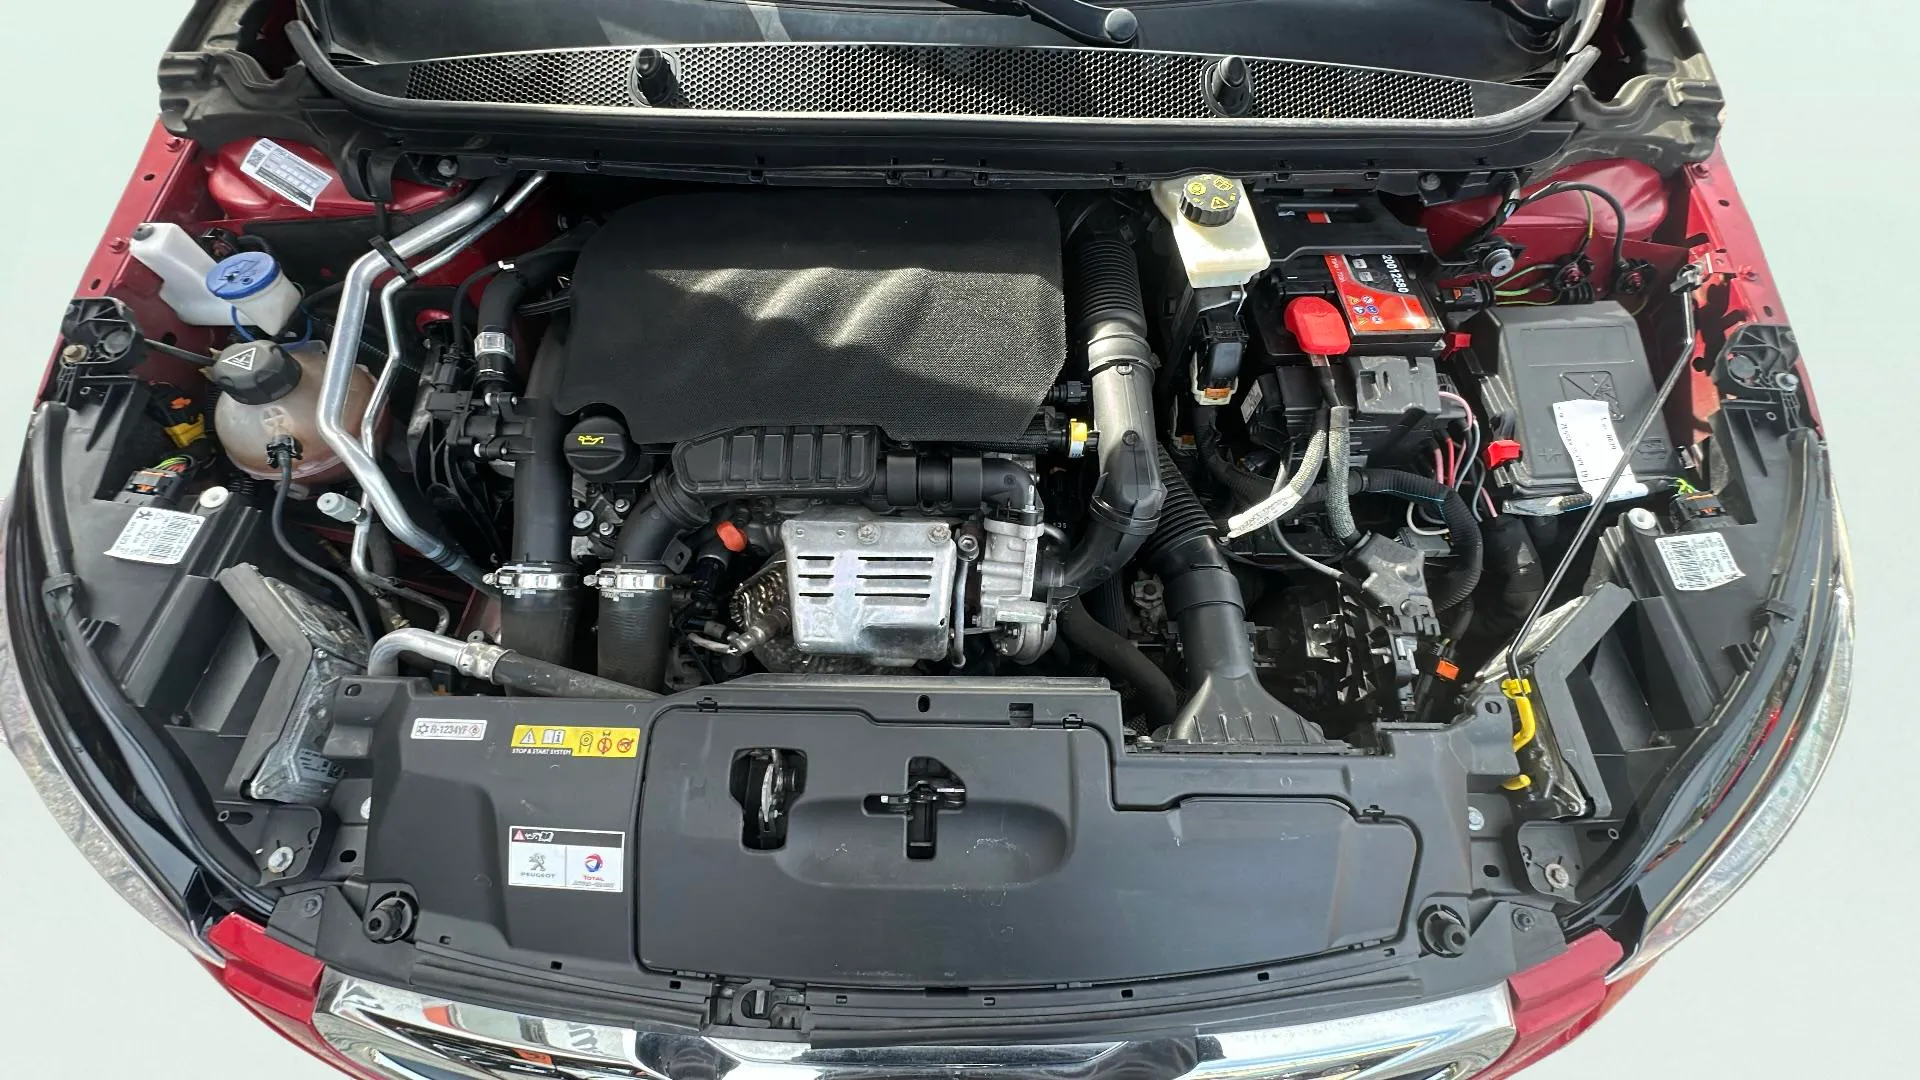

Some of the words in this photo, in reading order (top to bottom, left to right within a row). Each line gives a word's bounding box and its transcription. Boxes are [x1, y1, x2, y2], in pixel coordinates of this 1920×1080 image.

[1381, 254, 1409, 293] 20012580
[430, 724, 468, 735] R-1234YF
[520, 871, 556, 879] PEUGEOT
